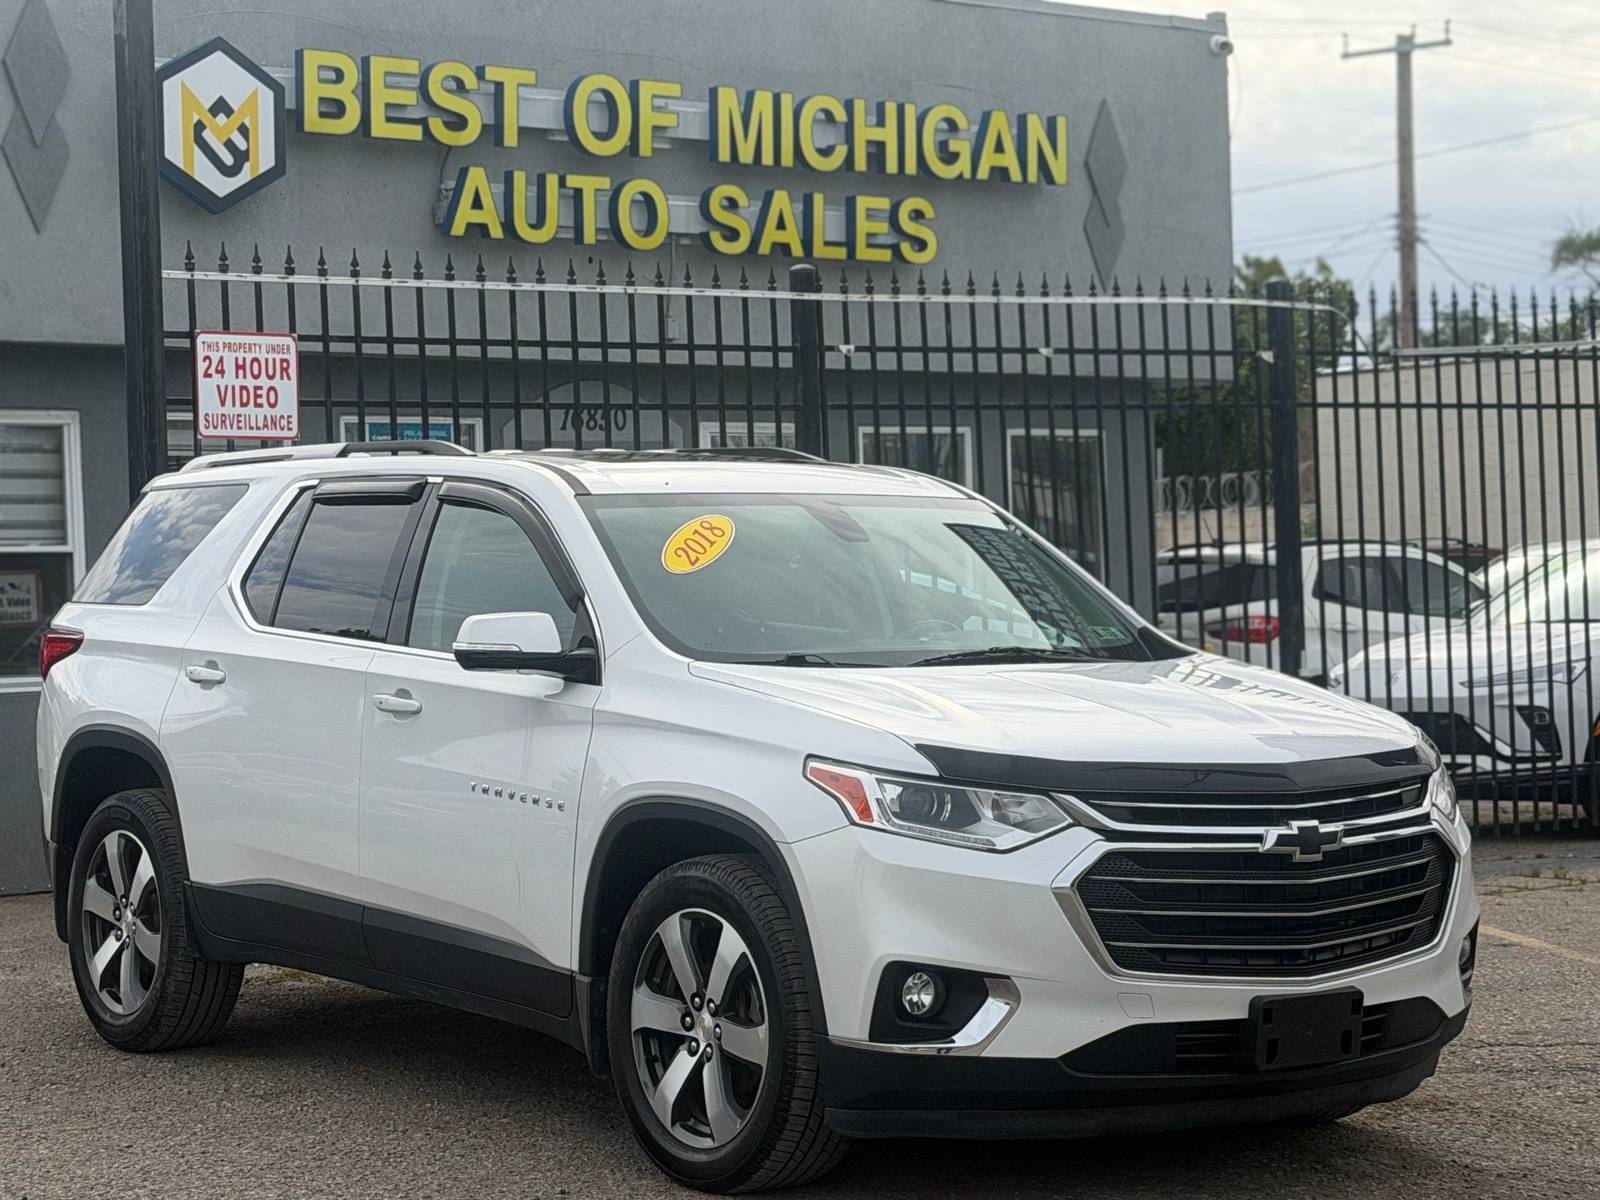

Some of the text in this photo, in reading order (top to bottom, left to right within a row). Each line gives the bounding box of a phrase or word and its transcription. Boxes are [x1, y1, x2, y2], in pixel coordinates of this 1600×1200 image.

[295, 48, 1068, 185] BEST OF MICHIGAN
[443, 166, 937, 265] AUTO SALES
[202, 341, 291, 355] THIS PROPERTY UNDER
[203, 355, 291, 381] 24 HOUR
[216, 384, 279, 409] VIDEO
[204, 413, 293, 431] SURVEILLANCE
[674, 521, 726, 566] 2018
[470, 782, 566, 812] TRAVERSE
